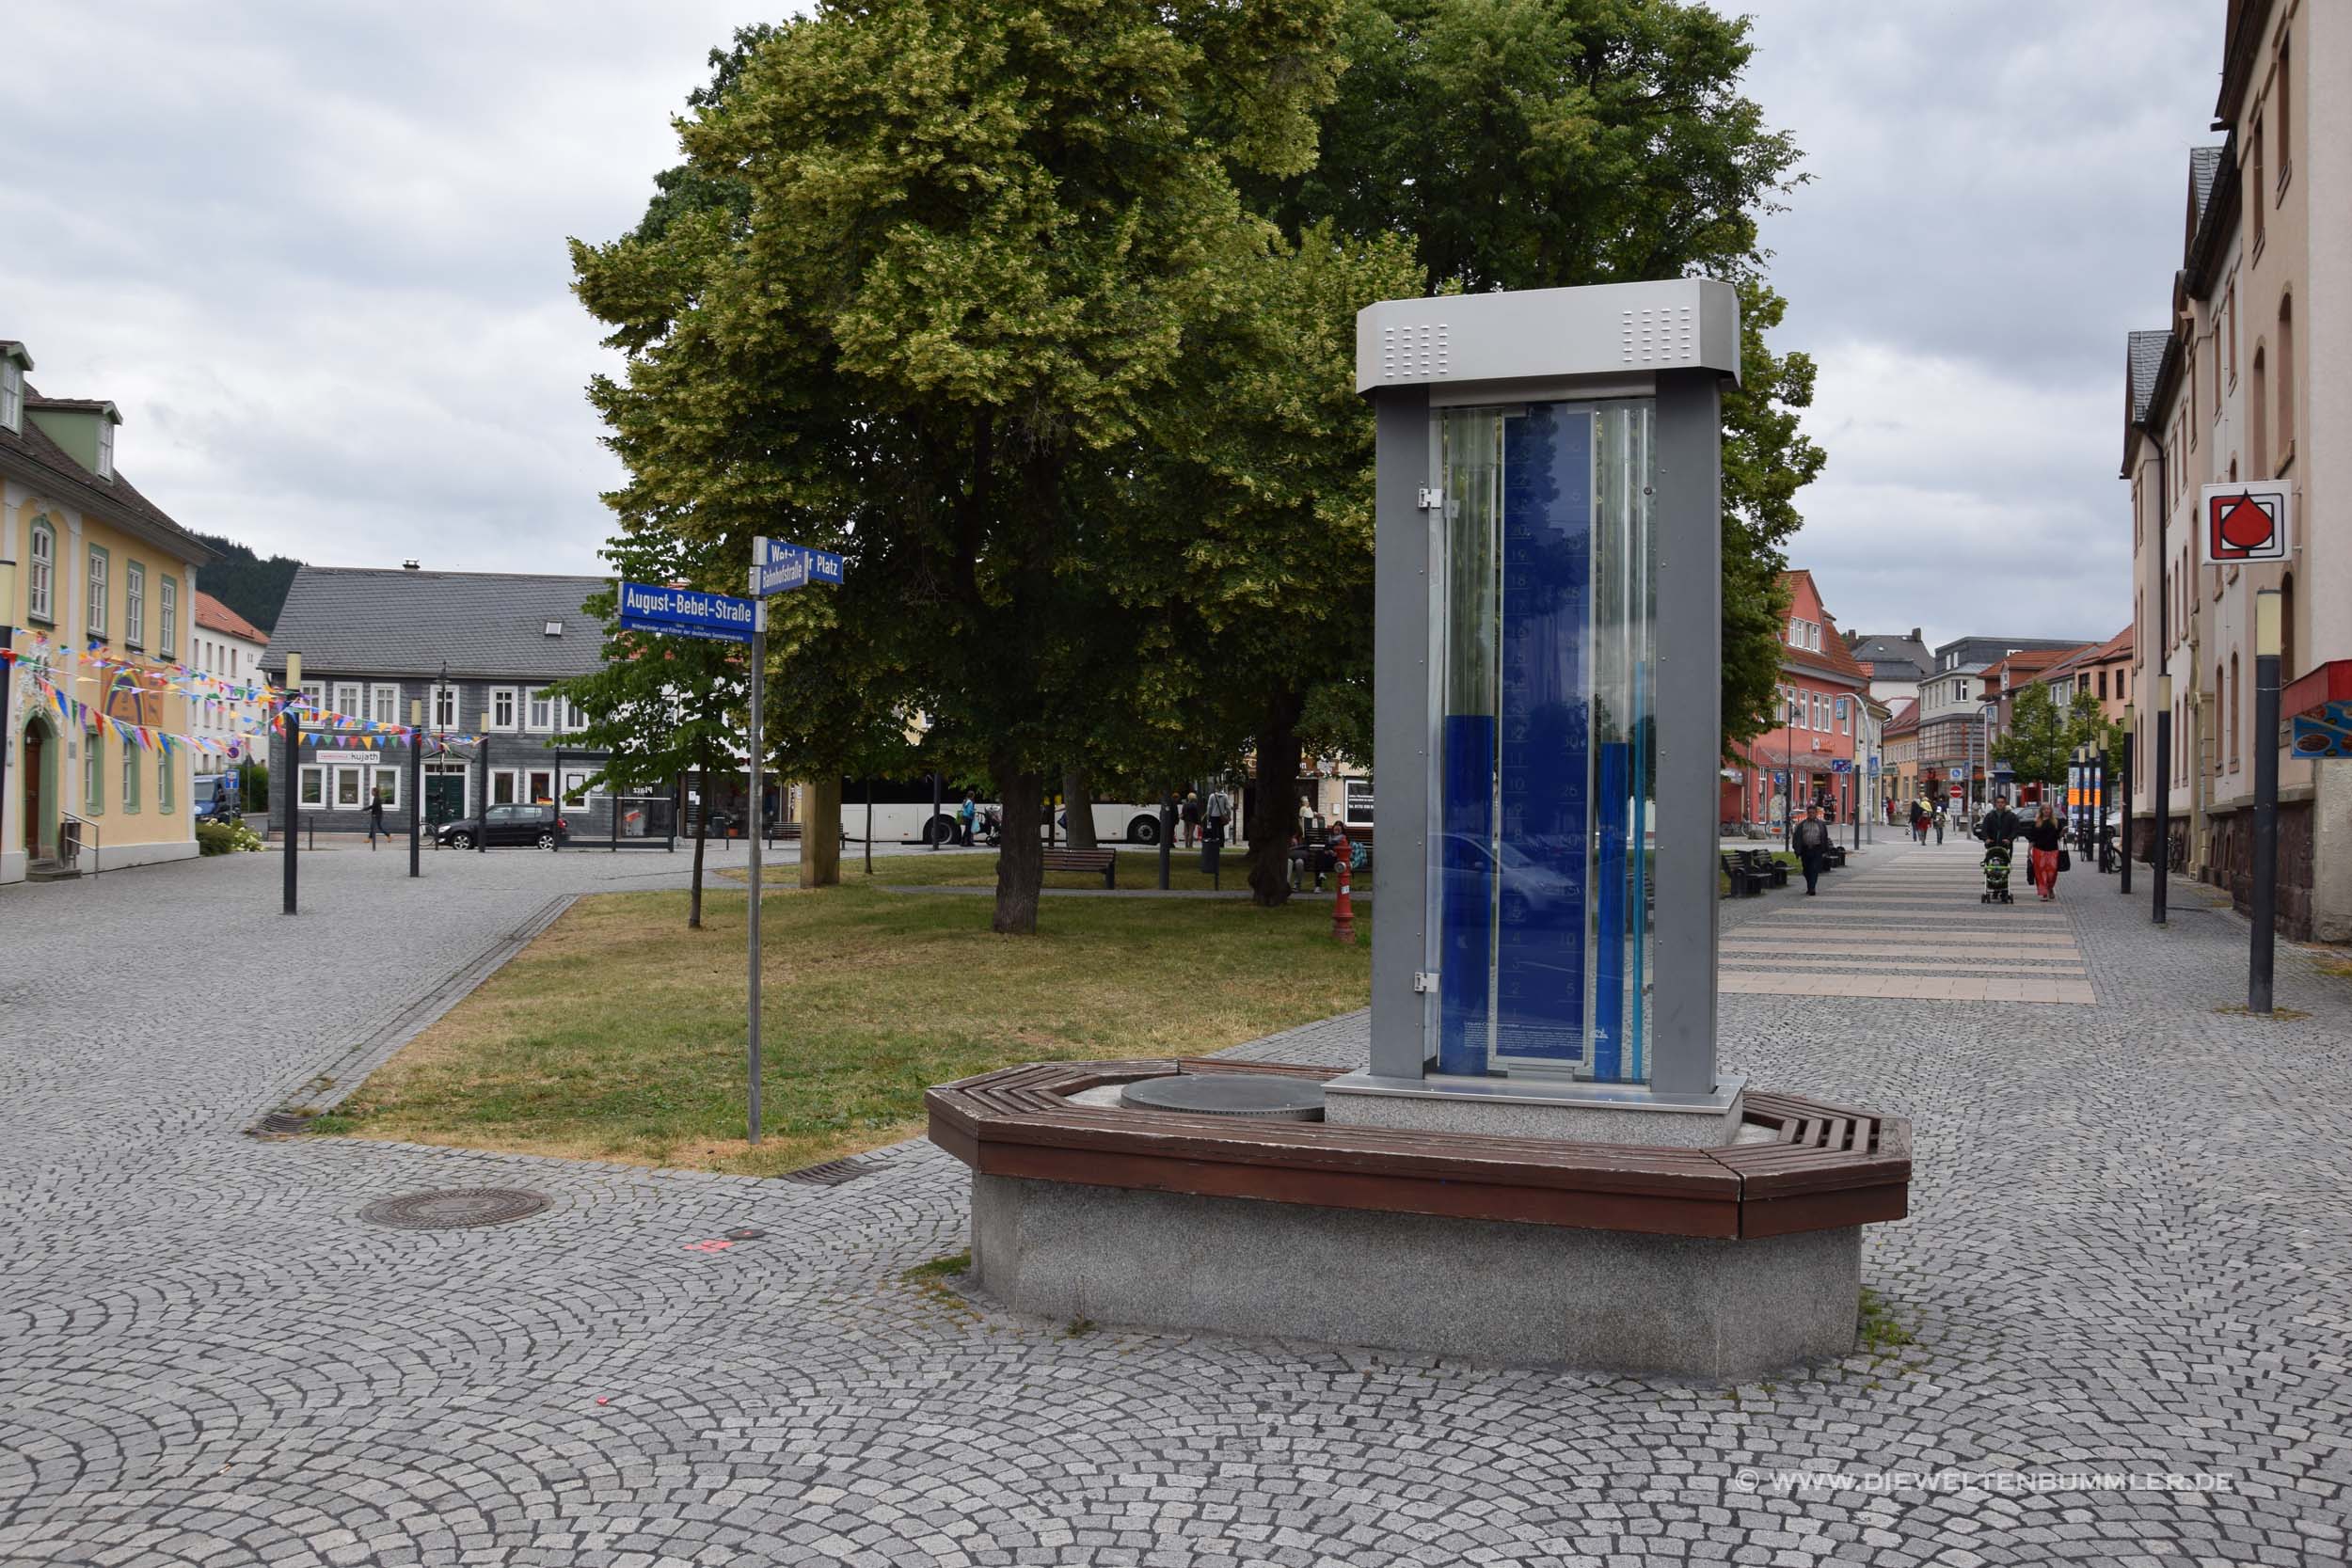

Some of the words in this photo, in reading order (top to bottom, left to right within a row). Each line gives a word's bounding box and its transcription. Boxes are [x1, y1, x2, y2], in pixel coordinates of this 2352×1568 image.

[762, 560, 803, 589] Bahnhofstraße
[817, 555, 838, 577] Platz
[627, 587, 752, 623] August-Bebel-Straße
[351, 752, 378, 762] kujath
[1510, 777, 1525, 791] 10
[1515, 828, 1522, 842] 8
